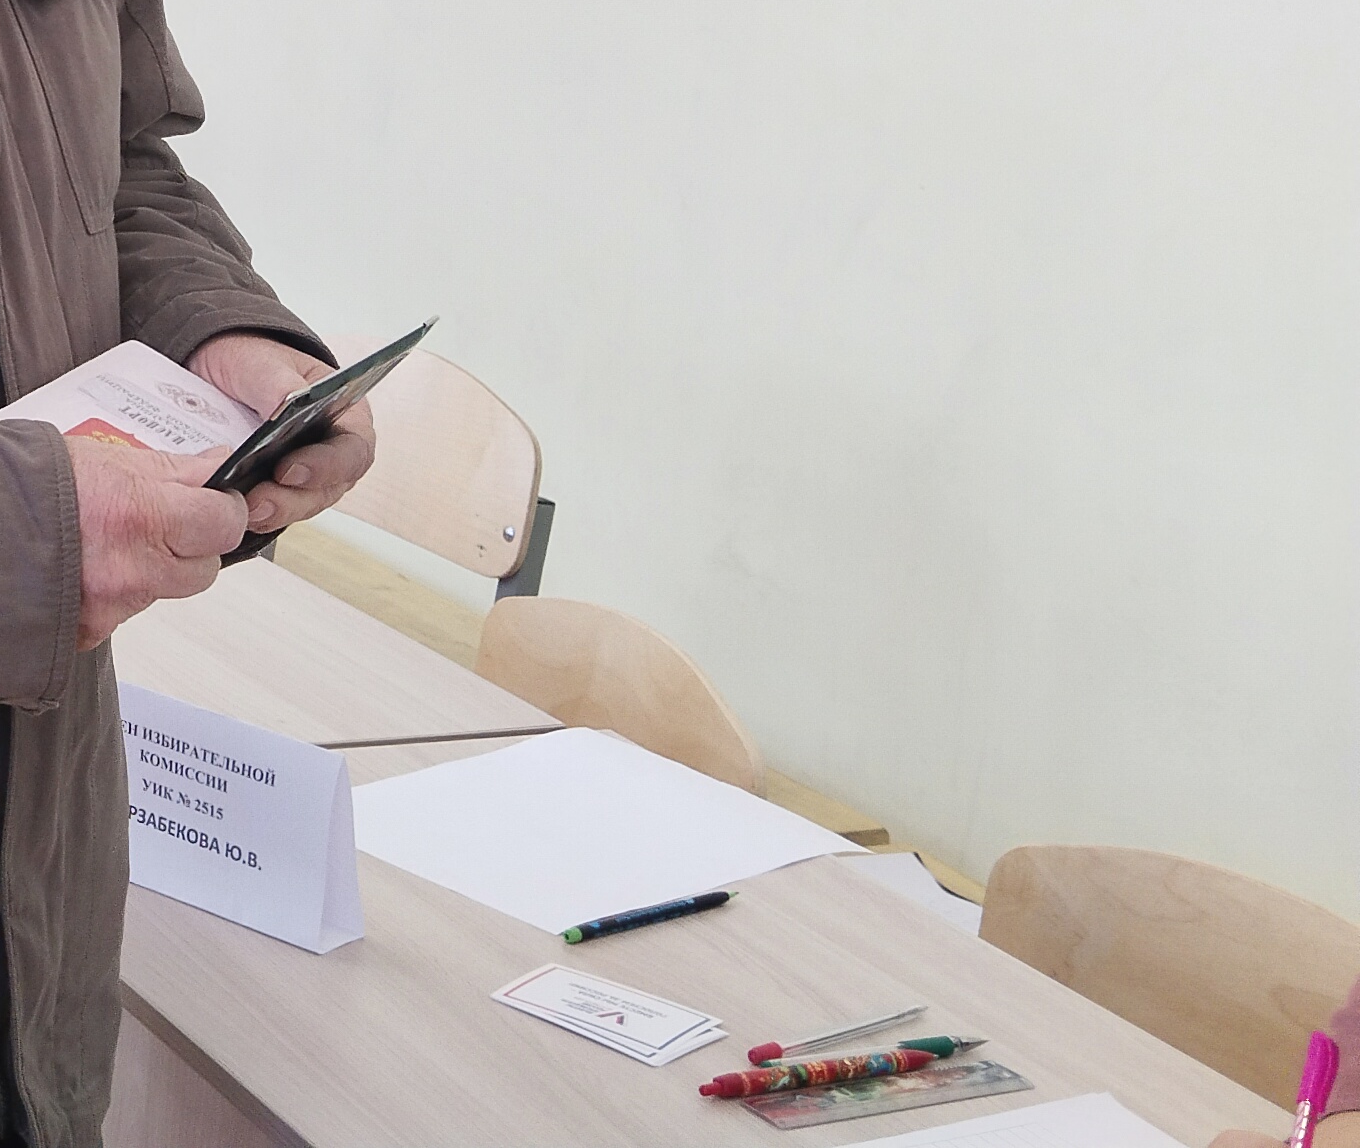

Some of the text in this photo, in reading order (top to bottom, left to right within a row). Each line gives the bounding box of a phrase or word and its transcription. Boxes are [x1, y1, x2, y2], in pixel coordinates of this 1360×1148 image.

[119, 405, 186, 445] ПАСПОРТ
[140, 749, 228, 793] КОМИССИИ
[142, 727, 276, 787] ИЗБИРАТЕЛЬНОЙ
[142, 778, 224, 821] УИК № 2515
[128, 805, 262, 871] РЗАБЕКОВА Ю.В.
